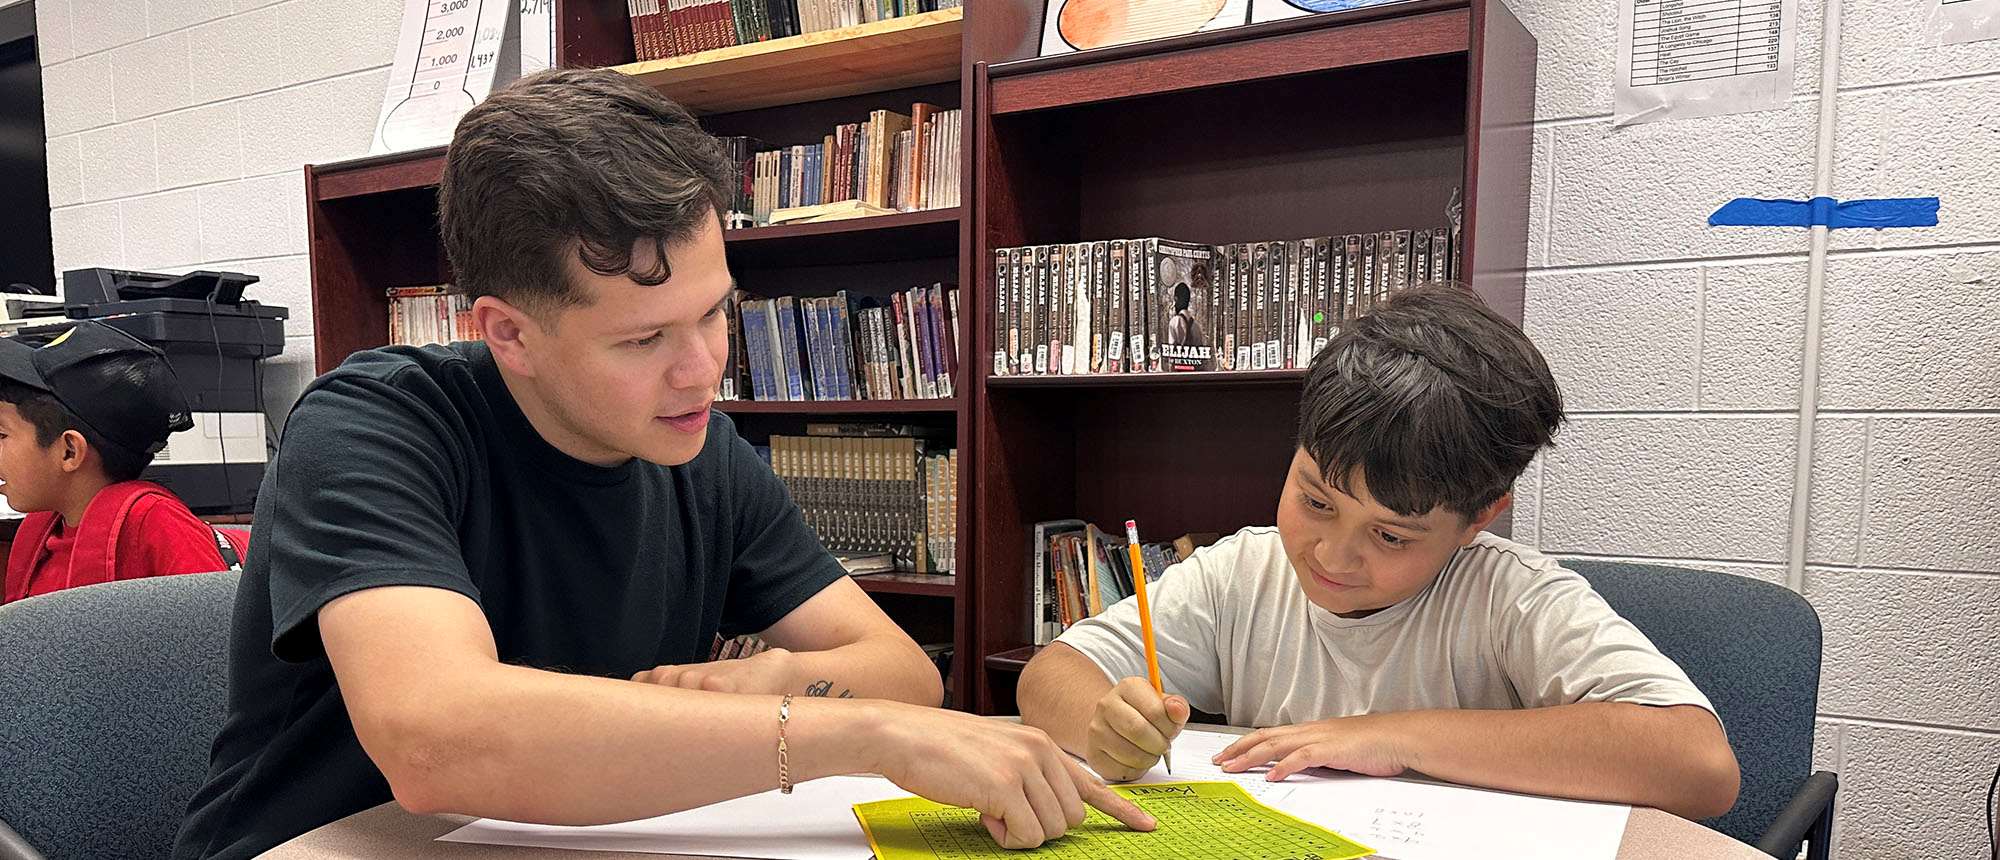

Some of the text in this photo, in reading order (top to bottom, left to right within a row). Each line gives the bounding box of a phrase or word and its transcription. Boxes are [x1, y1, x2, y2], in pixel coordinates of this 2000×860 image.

[433, 80, 441, 91] 0
[1333, 255, 1341, 293] ELIJAH
[1347, 267, 1355, 305] ELIJAH
[1364, 255, 1372, 295] ELIJAH
[1161, 344, 1212, 359] ELIJAH
